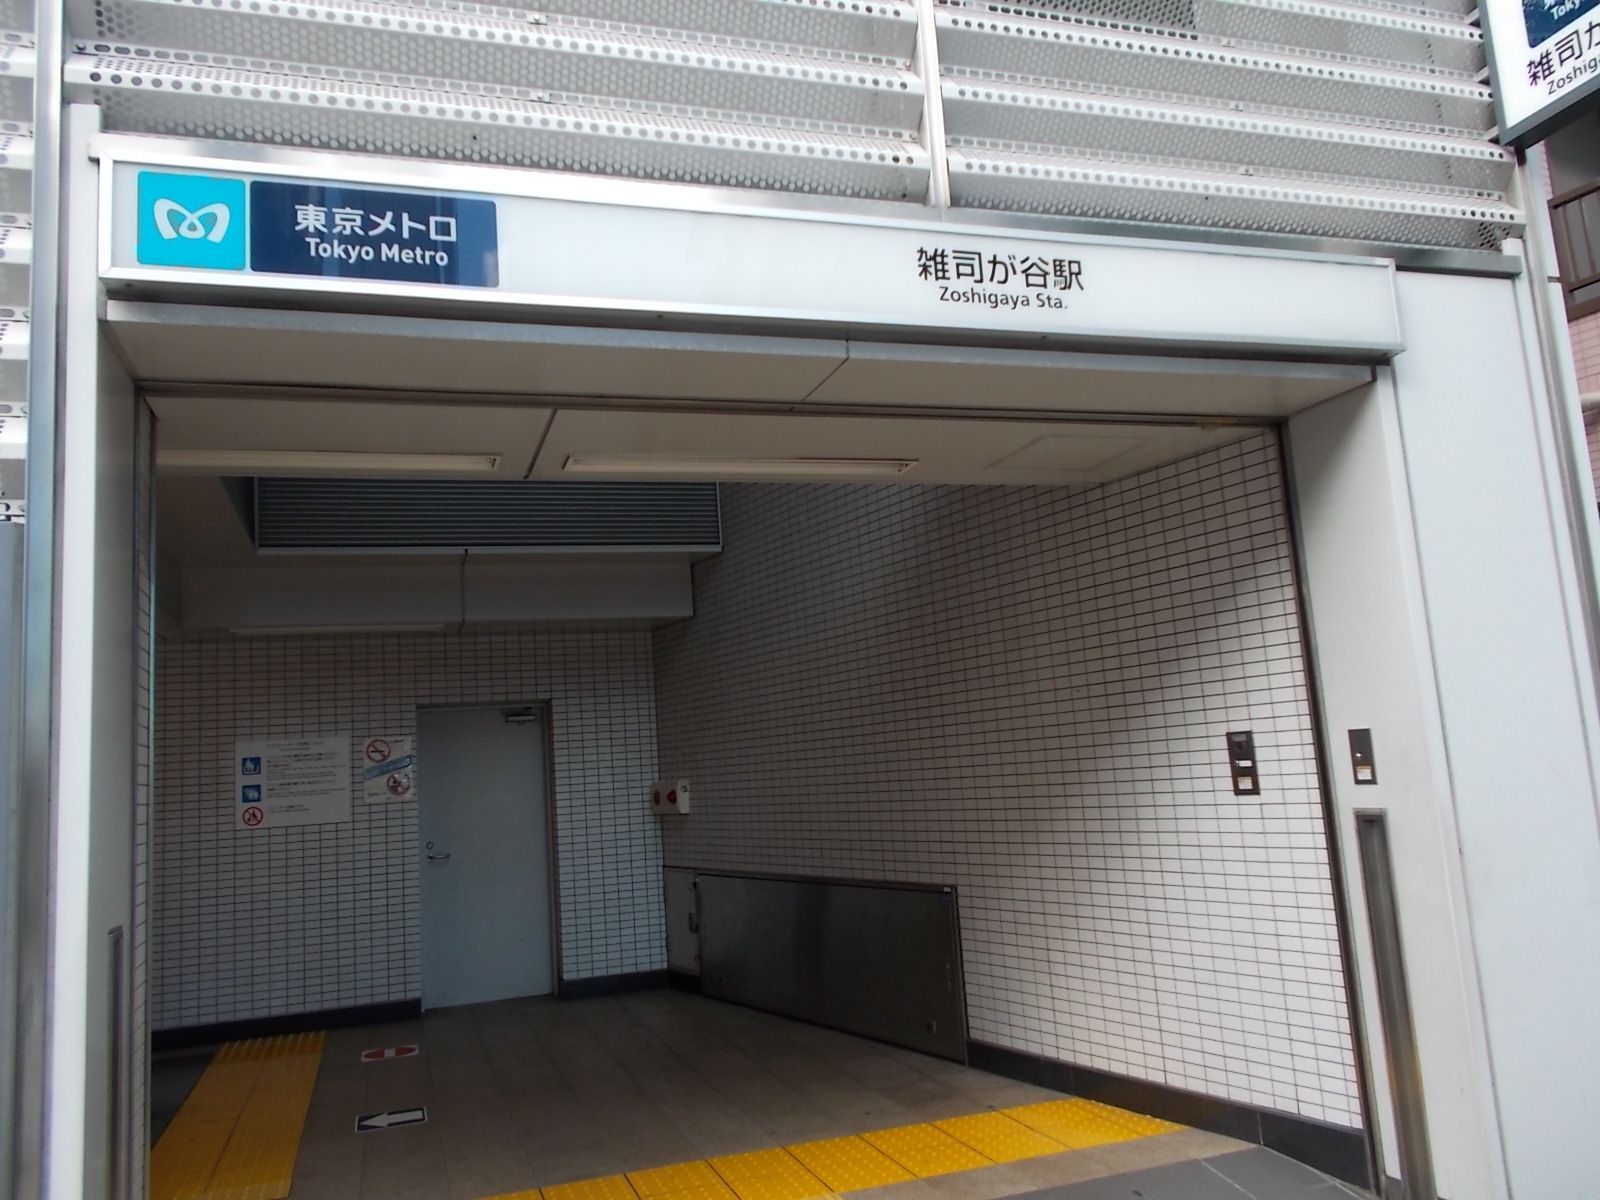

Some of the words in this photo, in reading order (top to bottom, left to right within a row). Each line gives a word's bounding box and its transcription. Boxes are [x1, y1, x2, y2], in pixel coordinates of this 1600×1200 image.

[1550, 0, 1584, 20] Toky
[1547, 55, 1600, 95] Zoshig
[294, 203, 457, 242] 東京メトロ
[305, 237, 374, 264] Tokyo
[380, 242, 449, 266] Metro
[916, 246, 1084, 291] 雑司が谷駅
[939, 286, 1030, 310] Zoshigaya
[1036, 292, 1068, 310] Sta.
